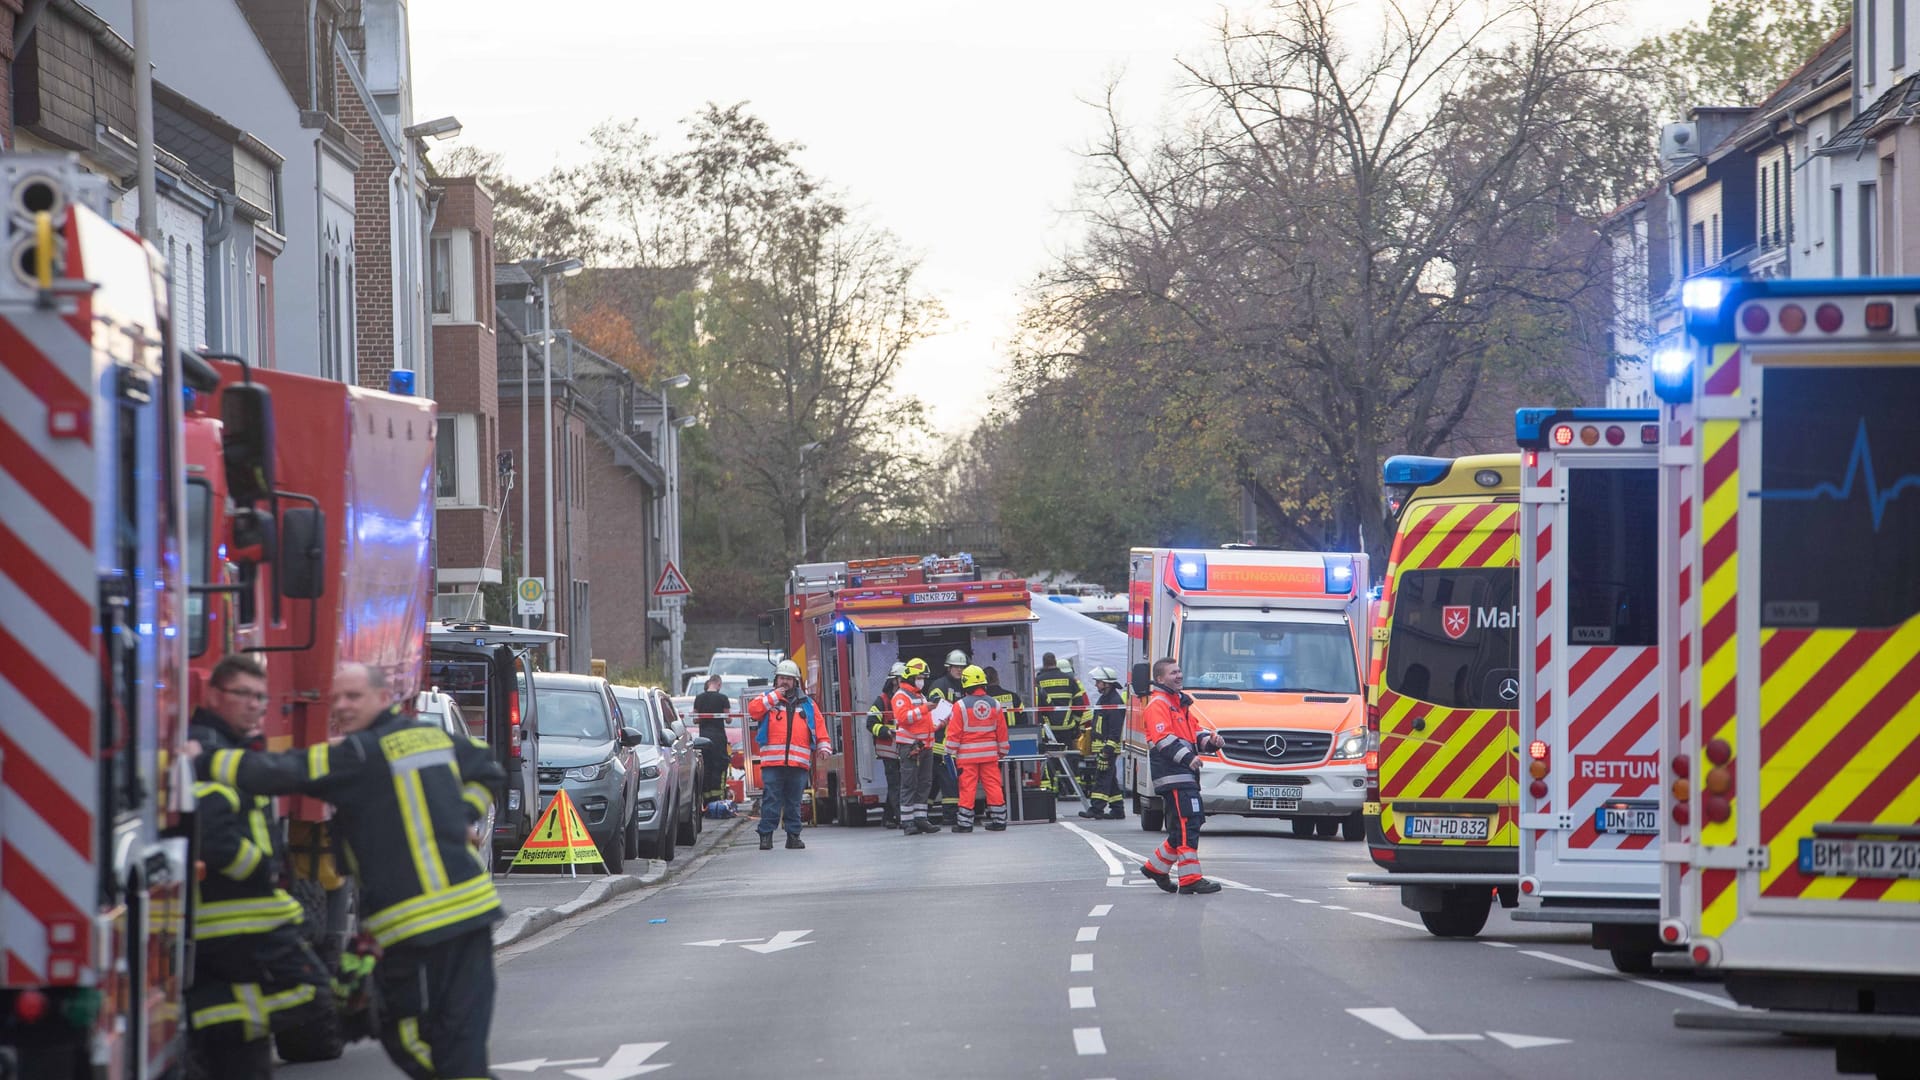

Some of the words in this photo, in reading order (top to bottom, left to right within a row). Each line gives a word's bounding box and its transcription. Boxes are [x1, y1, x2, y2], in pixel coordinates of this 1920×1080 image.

[1213, 570, 1320, 583] RETTUNGSWAGEN
[941, 592, 955, 601] 792
[1477, 605, 1520, 628] Mal
[1577, 629, 1604, 638] WAS
[1582, 761, 1660, 778] RETTUN
[1253, 787, 1264, 797] HS
[1270, 787, 1280, 797] RD
[1281, 788, 1301, 797] 6020
[1607, 811, 1626, 827] DN
[1636, 812, 1656, 828] RD
[1414, 819, 1432, 833] DN
[1440, 819, 1458, 834] HD
[1460, 820, 1486, 835] 832
[522, 849, 567, 861] Registrierung
[1815, 844, 1841, 867] BM
[1858, 845, 1885, 868] RD
